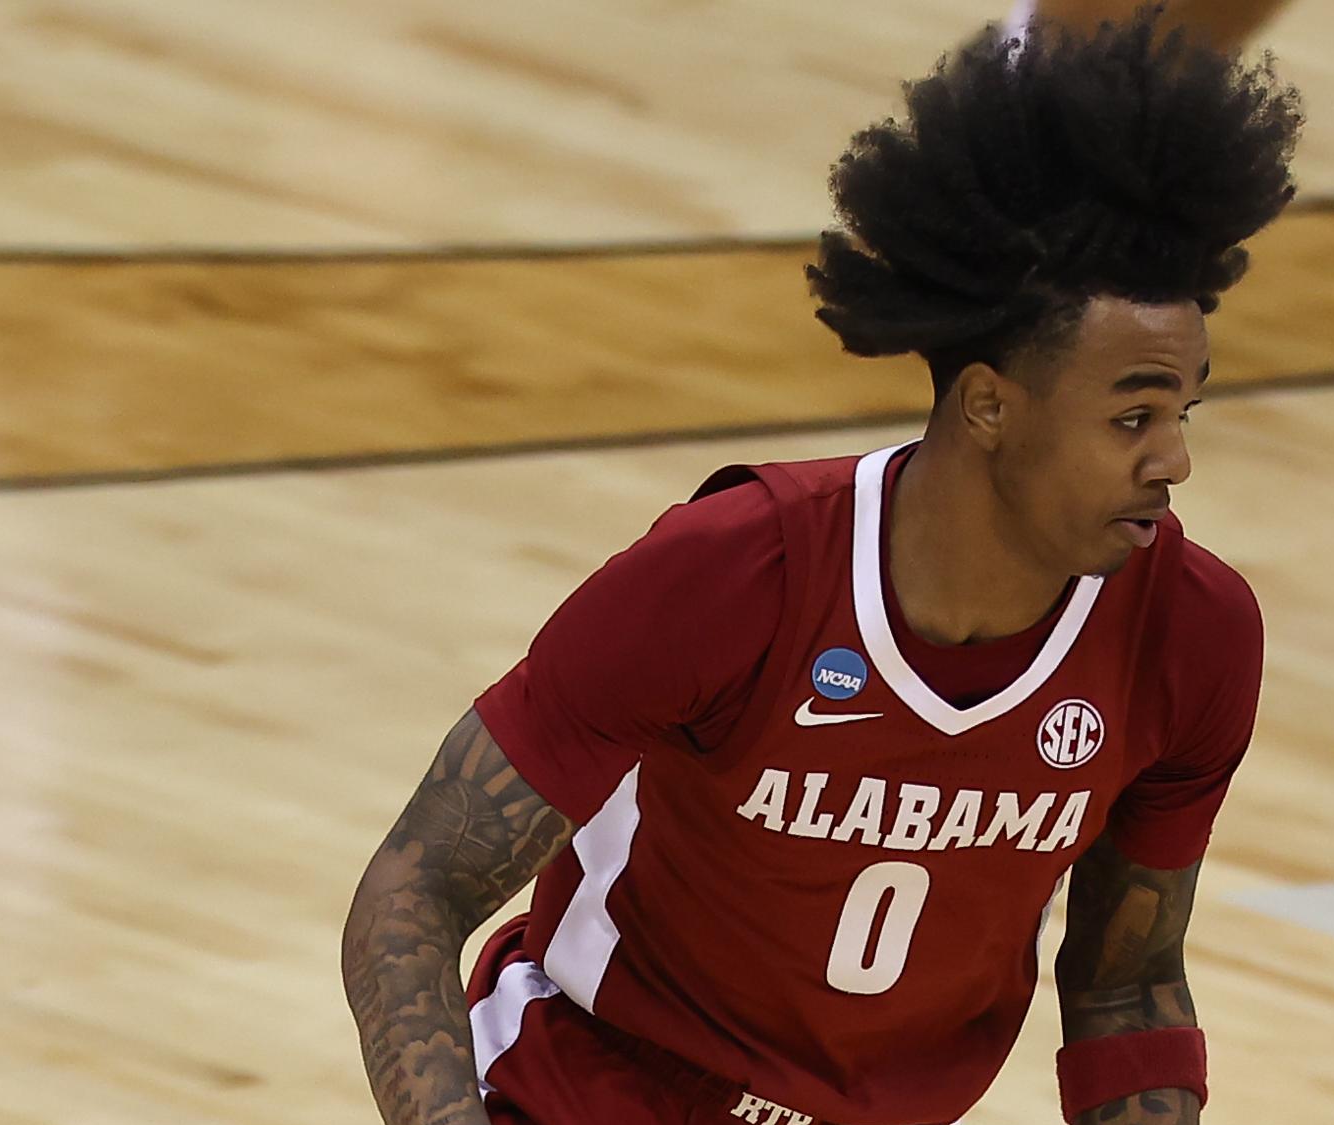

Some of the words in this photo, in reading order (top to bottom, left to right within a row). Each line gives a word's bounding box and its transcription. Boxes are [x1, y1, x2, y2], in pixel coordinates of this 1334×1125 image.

[816, 668, 862, 692] NCAA
[1044, 707, 1100, 763] SEC
[737, 768, 1091, 852] ALABAMA
[826, 861, 930, 995] 0
